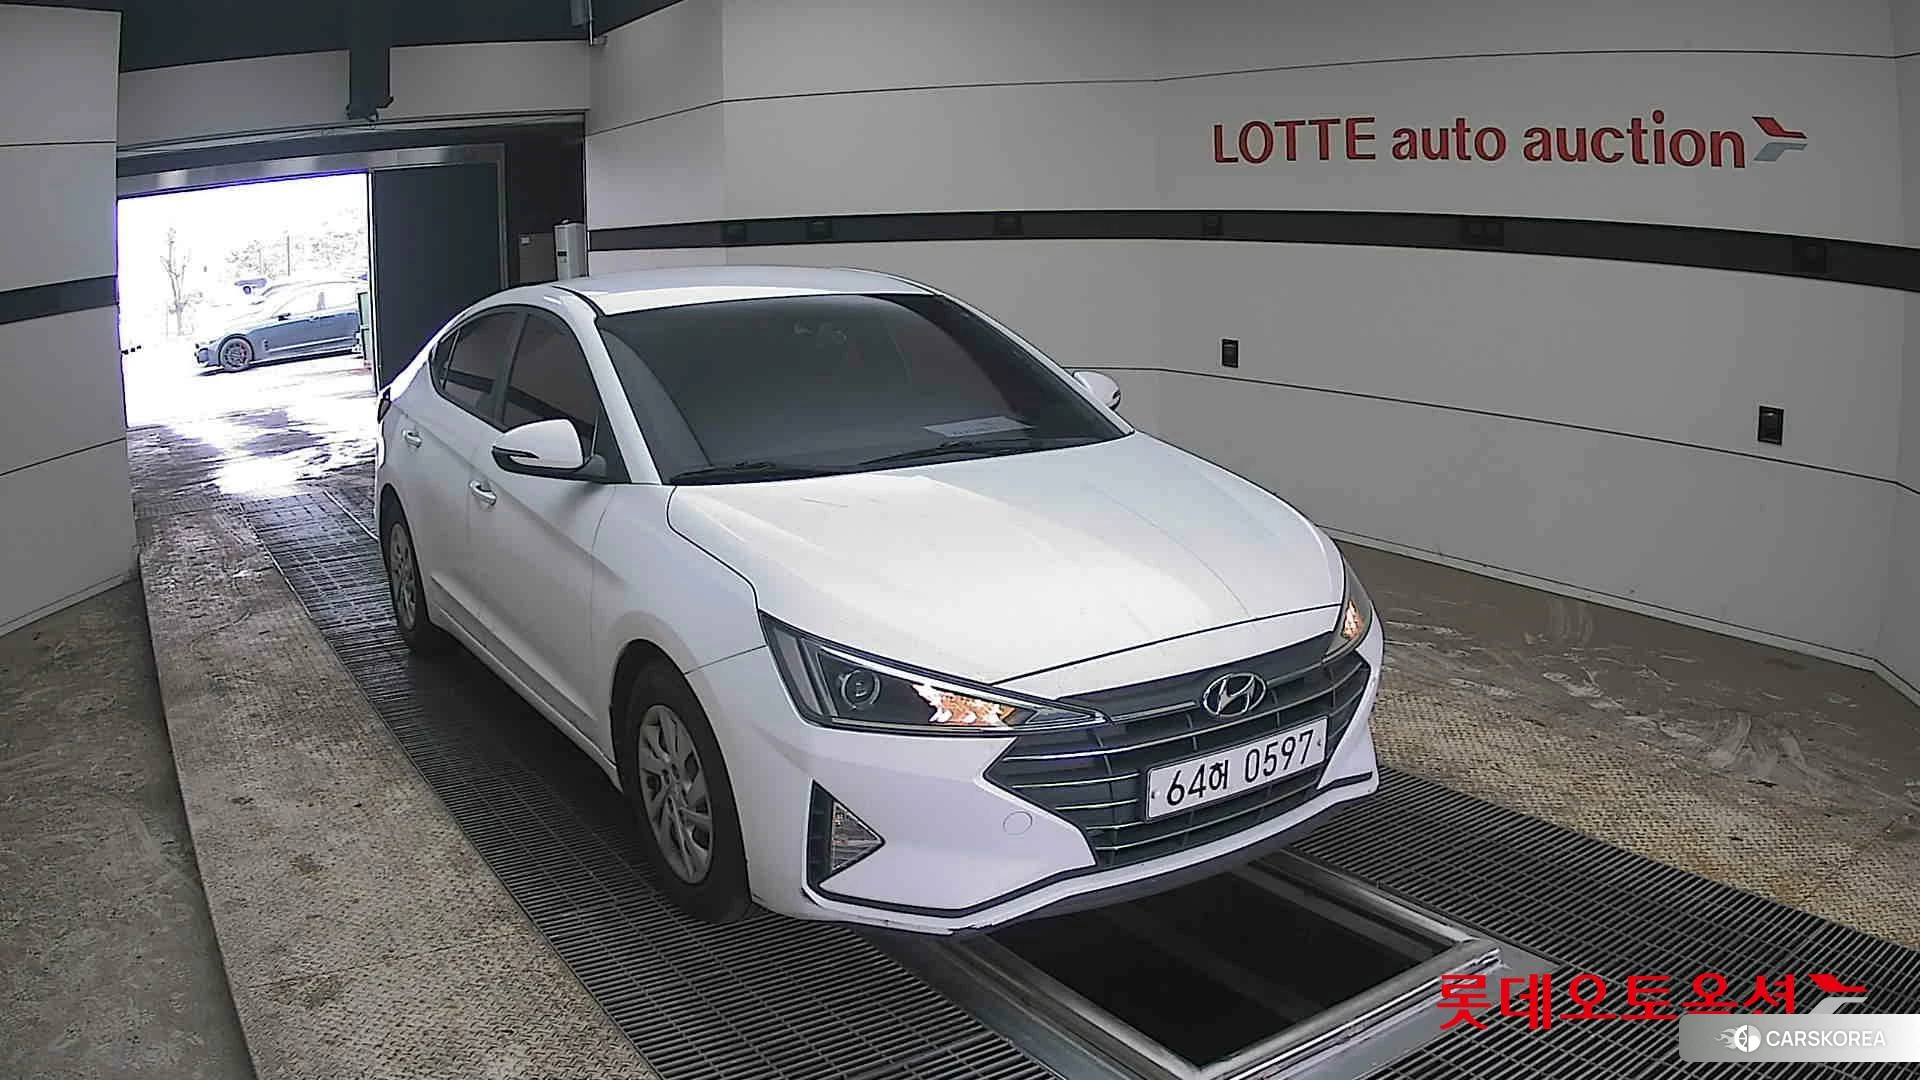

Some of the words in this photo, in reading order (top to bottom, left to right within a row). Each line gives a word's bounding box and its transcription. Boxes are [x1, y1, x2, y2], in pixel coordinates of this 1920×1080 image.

[1213, 116, 1376, 164] LOTTE
[1391, 117, 1507, 162] auto
[1522, 110, 1746, 169] auction
[1166, 759, 1229, 806] 64허
[1244, 729, 1314, 783] 0597
